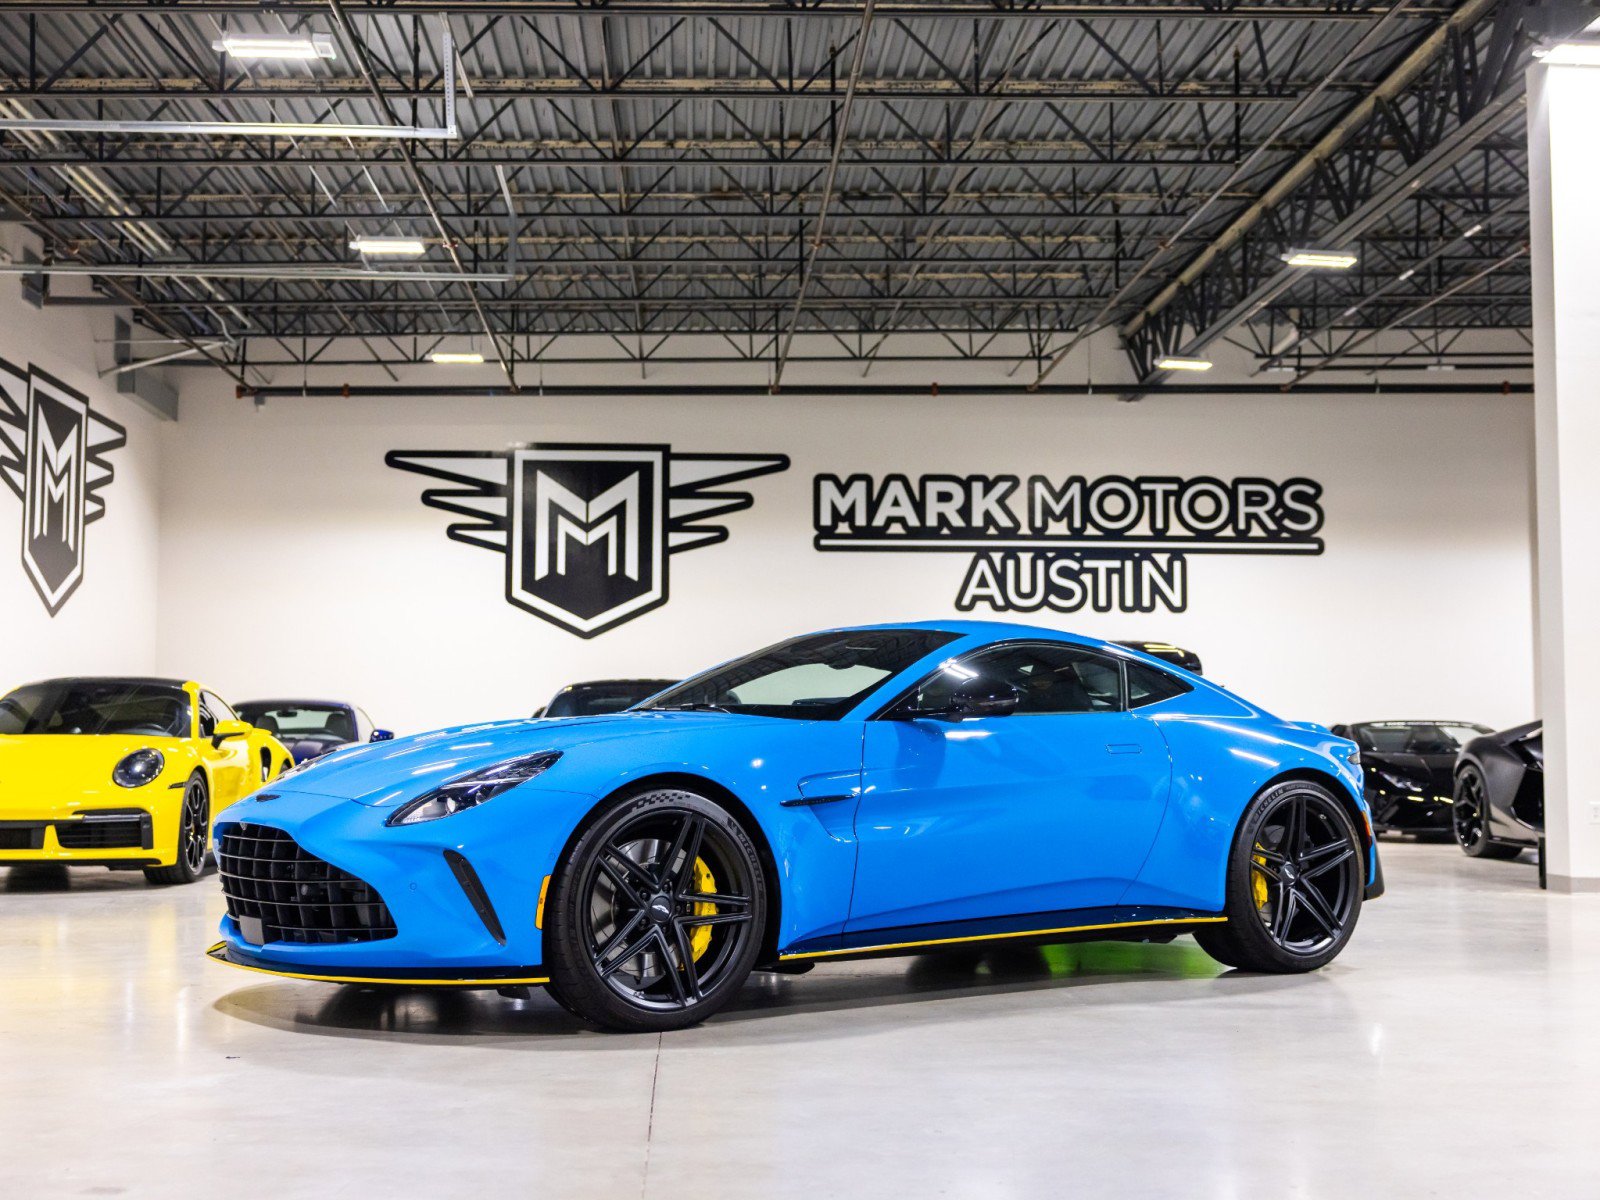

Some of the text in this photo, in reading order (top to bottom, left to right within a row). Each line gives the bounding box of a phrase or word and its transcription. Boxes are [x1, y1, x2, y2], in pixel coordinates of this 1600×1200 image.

[818, 479, 1320, 534] MARK MOTORS
[959, 558, 1183, 609] AUSTIN
[1253, 787, 1284, 823] MICHELIN
